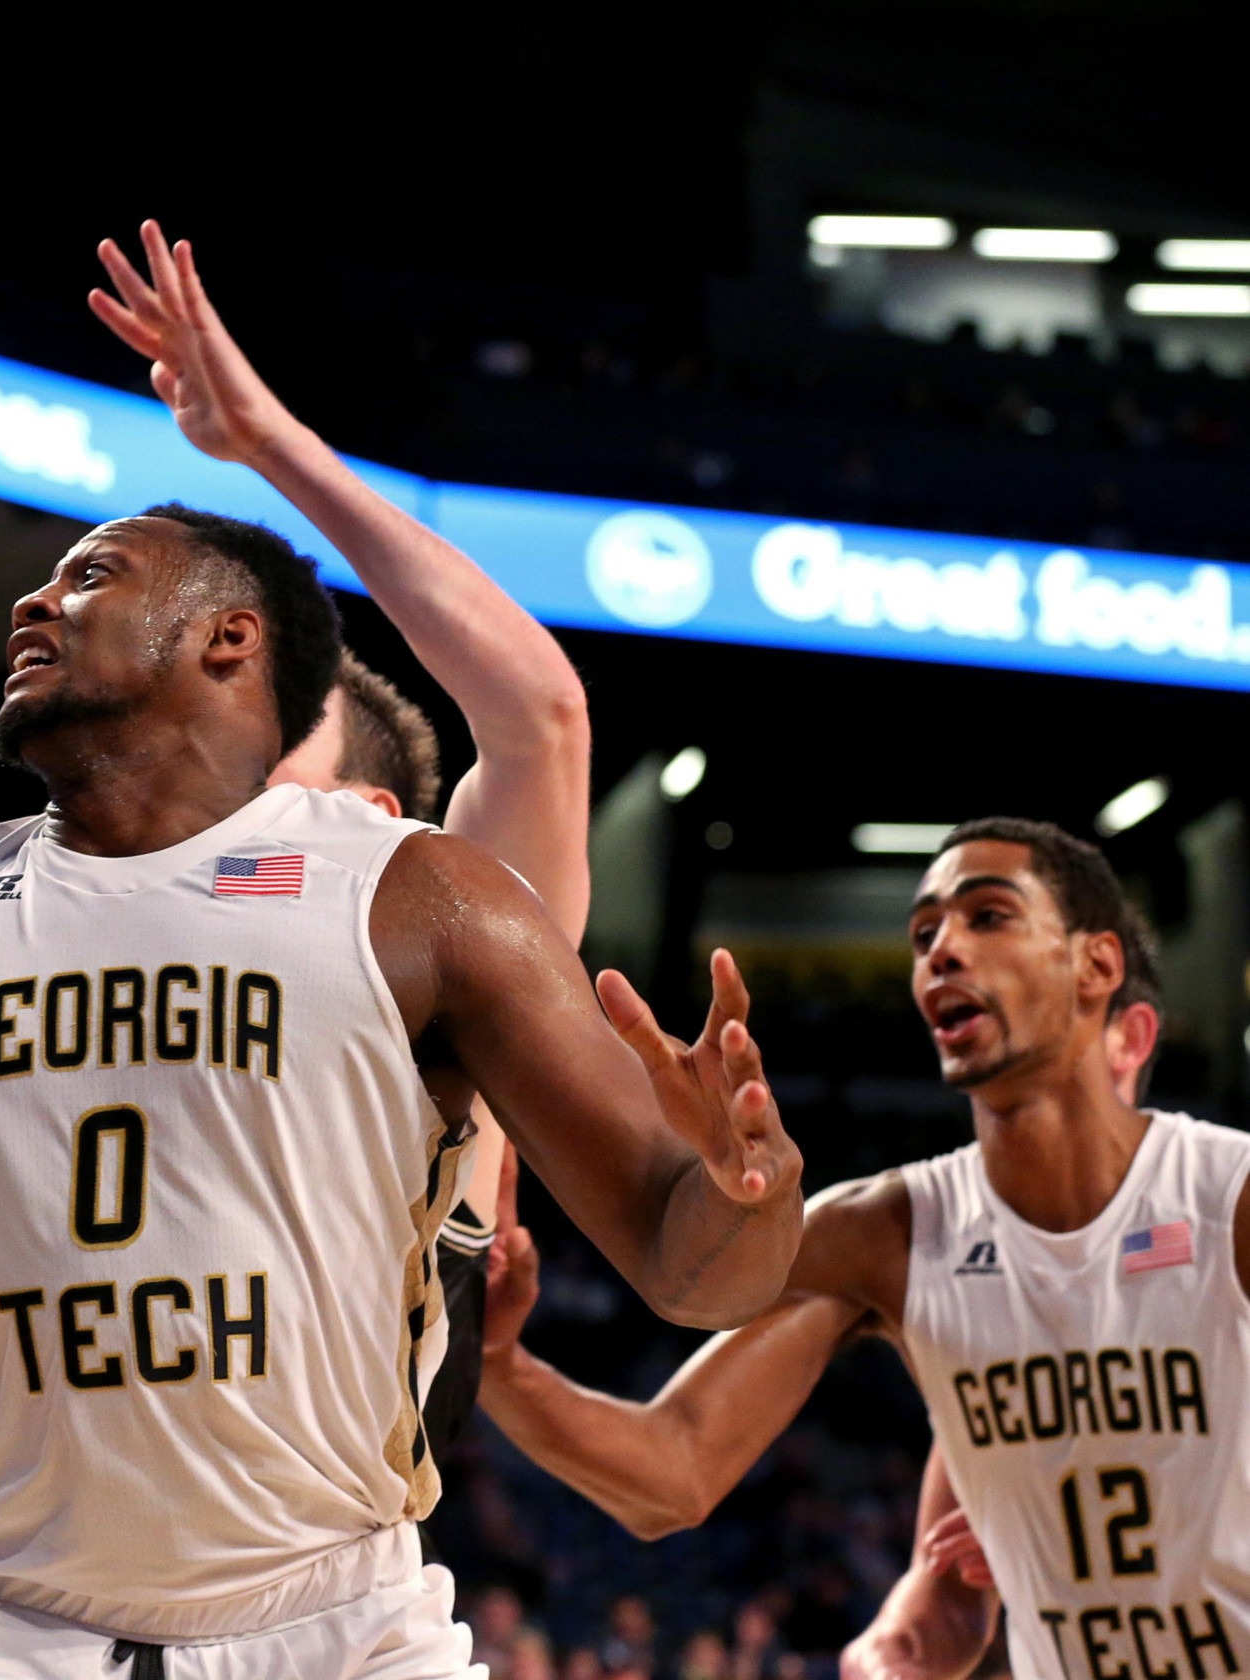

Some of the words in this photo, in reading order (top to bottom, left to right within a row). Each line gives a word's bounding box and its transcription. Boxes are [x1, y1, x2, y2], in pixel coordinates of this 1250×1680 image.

[753, 523, 1026, 641] Great
[69, 1103, 148, 1251] 0
[953, 1349, 1209, 1447] GEORGIA
[1058, 1465, 1157, 1583] 12
[1038, 1601, 1242, 1680] TECH
